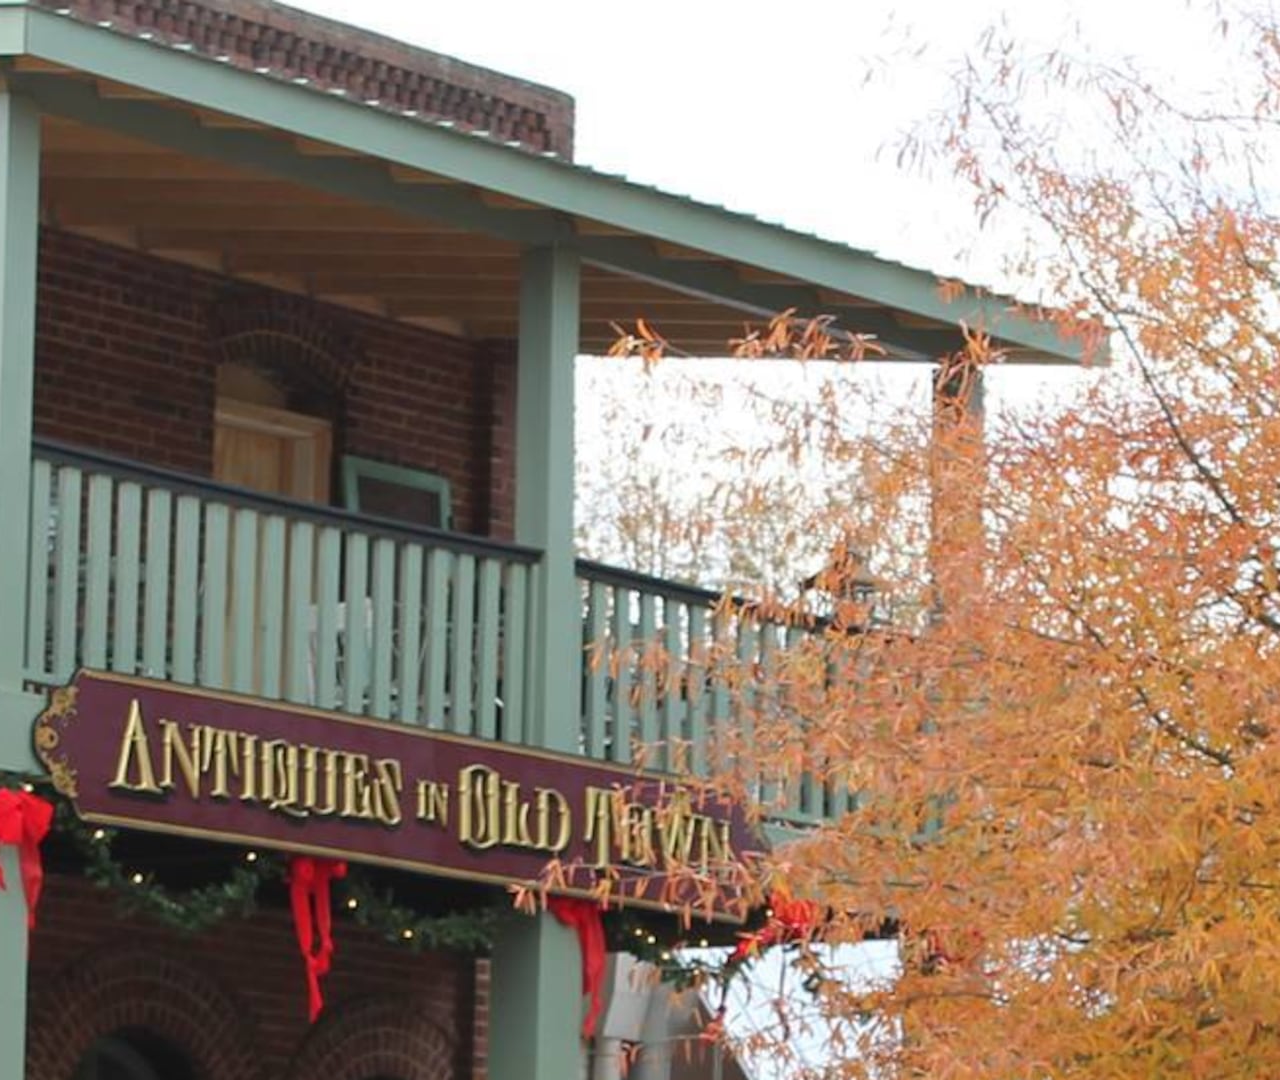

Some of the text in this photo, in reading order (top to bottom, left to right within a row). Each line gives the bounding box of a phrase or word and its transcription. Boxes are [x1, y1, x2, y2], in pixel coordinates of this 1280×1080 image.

[108, 699, 402, 826] ANTIQUES
[416, 779, 449, 828] IN
[458, 763, 571, 850] OLD
